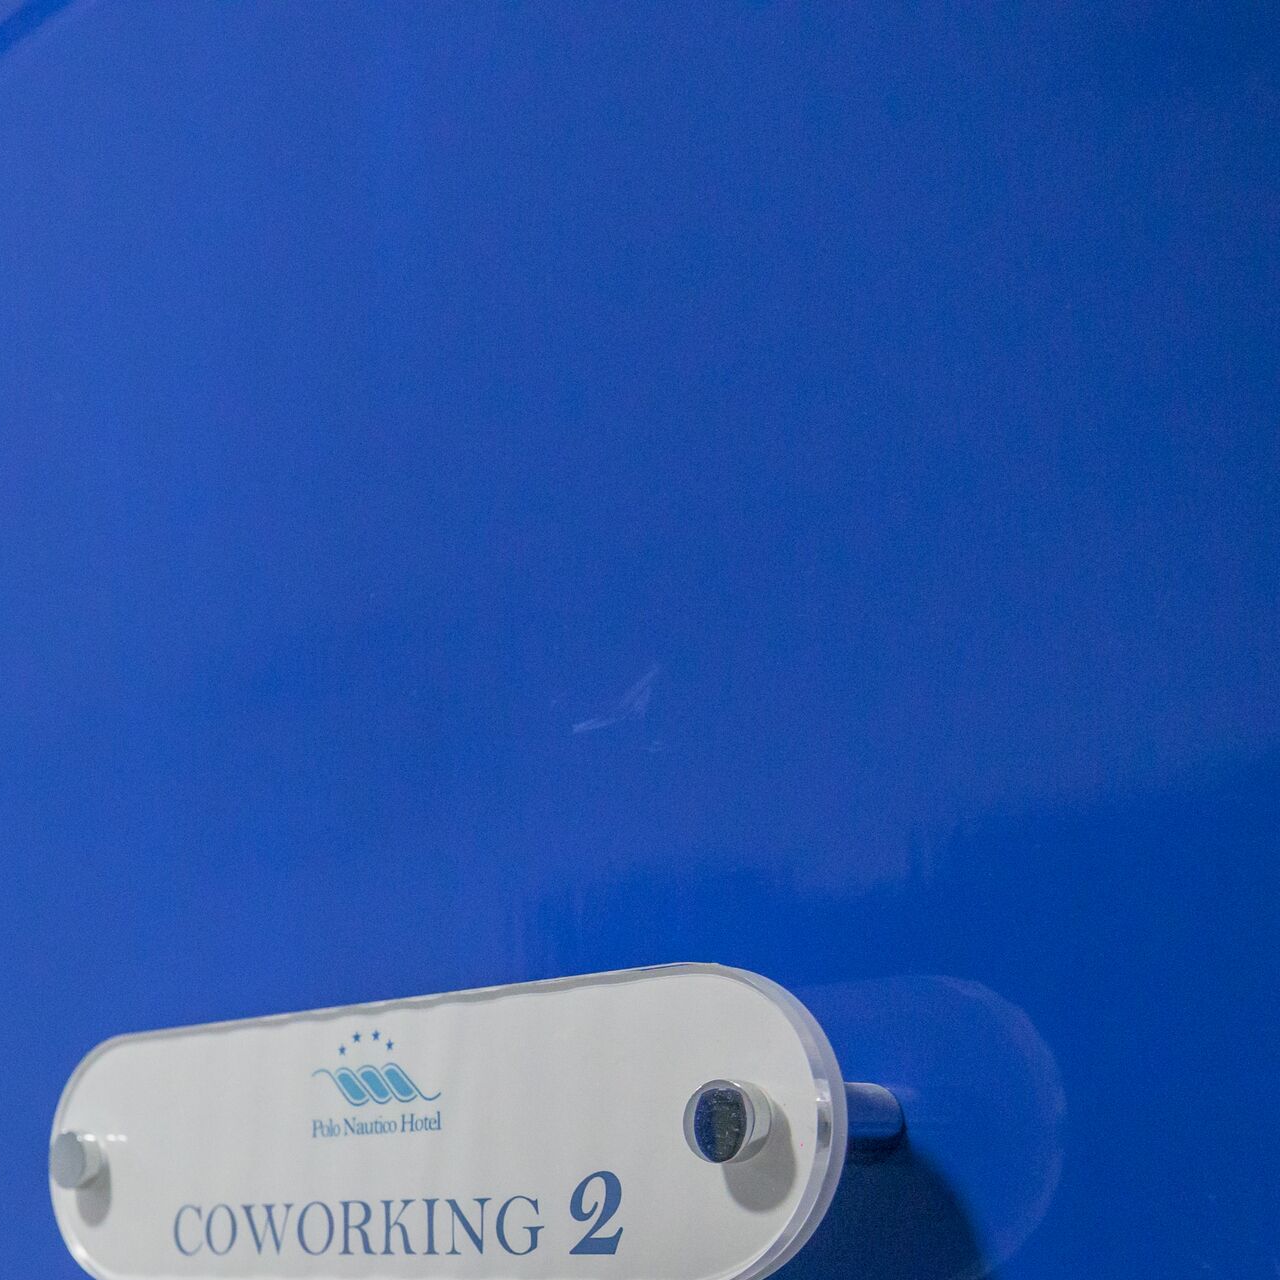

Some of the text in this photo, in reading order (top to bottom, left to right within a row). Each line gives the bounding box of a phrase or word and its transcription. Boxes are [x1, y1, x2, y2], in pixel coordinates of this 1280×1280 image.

[312, 1111, 442, 1138] Polo Nautico Hotel
[173, 1170, 624, 1257] COWORKING 2
